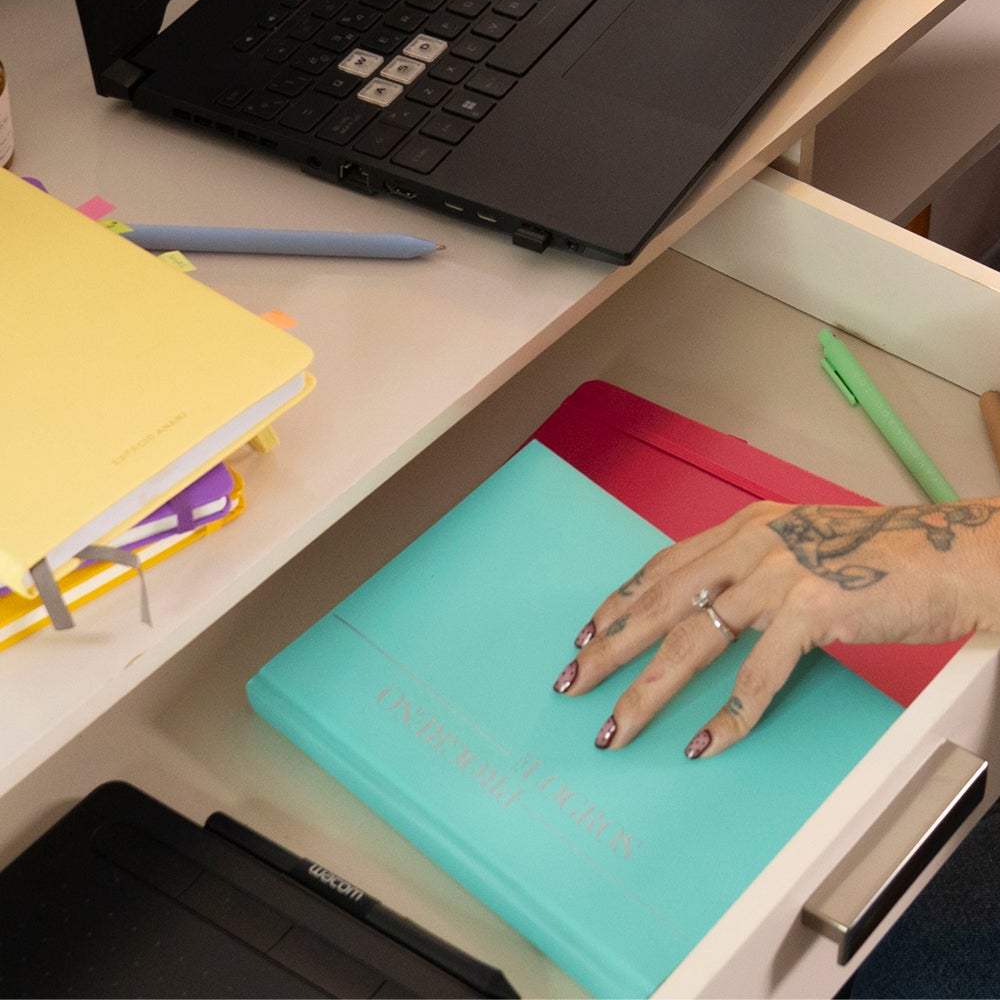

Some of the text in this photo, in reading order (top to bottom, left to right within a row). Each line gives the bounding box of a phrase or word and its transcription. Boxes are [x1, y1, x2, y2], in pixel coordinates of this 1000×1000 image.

[354, 56, 367, 66] W
[397, 64, 409, 72] S
[376, 87, 386, 95] A
[308, 863, 364, 902] wacom
